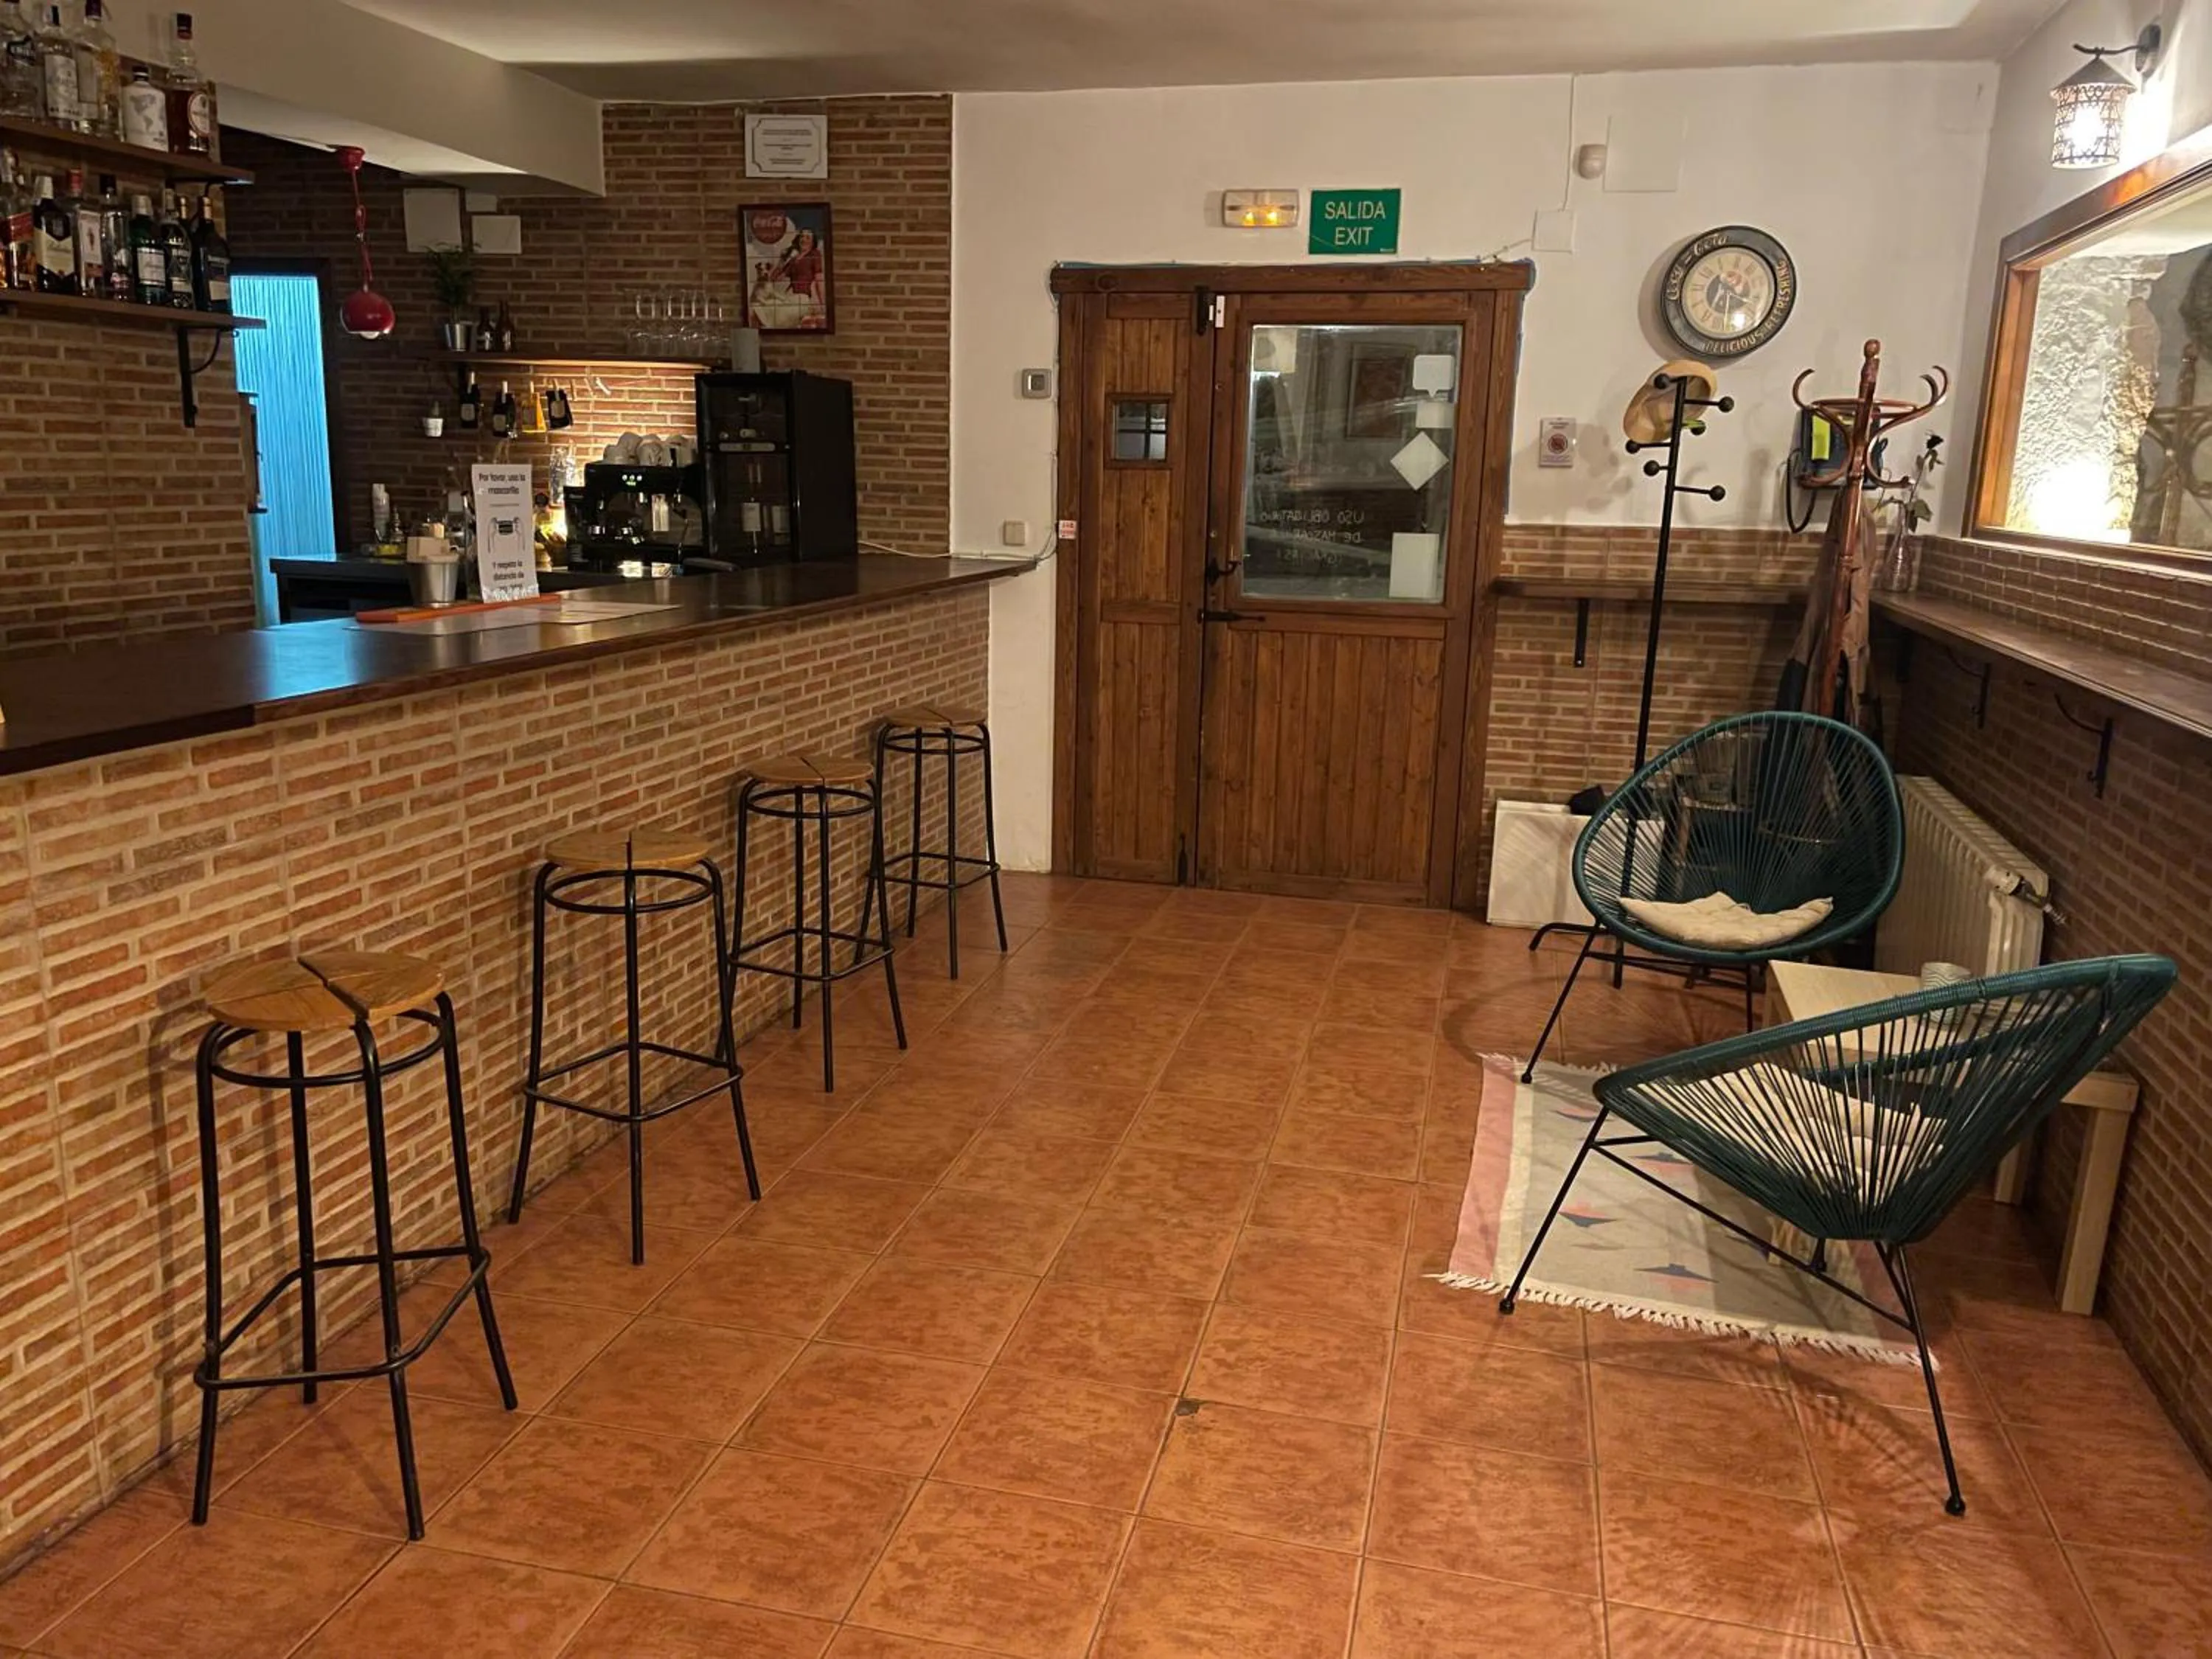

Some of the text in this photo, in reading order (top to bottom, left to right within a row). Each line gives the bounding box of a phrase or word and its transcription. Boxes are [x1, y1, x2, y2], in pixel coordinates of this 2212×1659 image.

[1324, 201, 1386, 220] SALIDA
[1335, 226, 1374, 246] EXIT
[1764, 258, 1790, 330] REFRESHING
